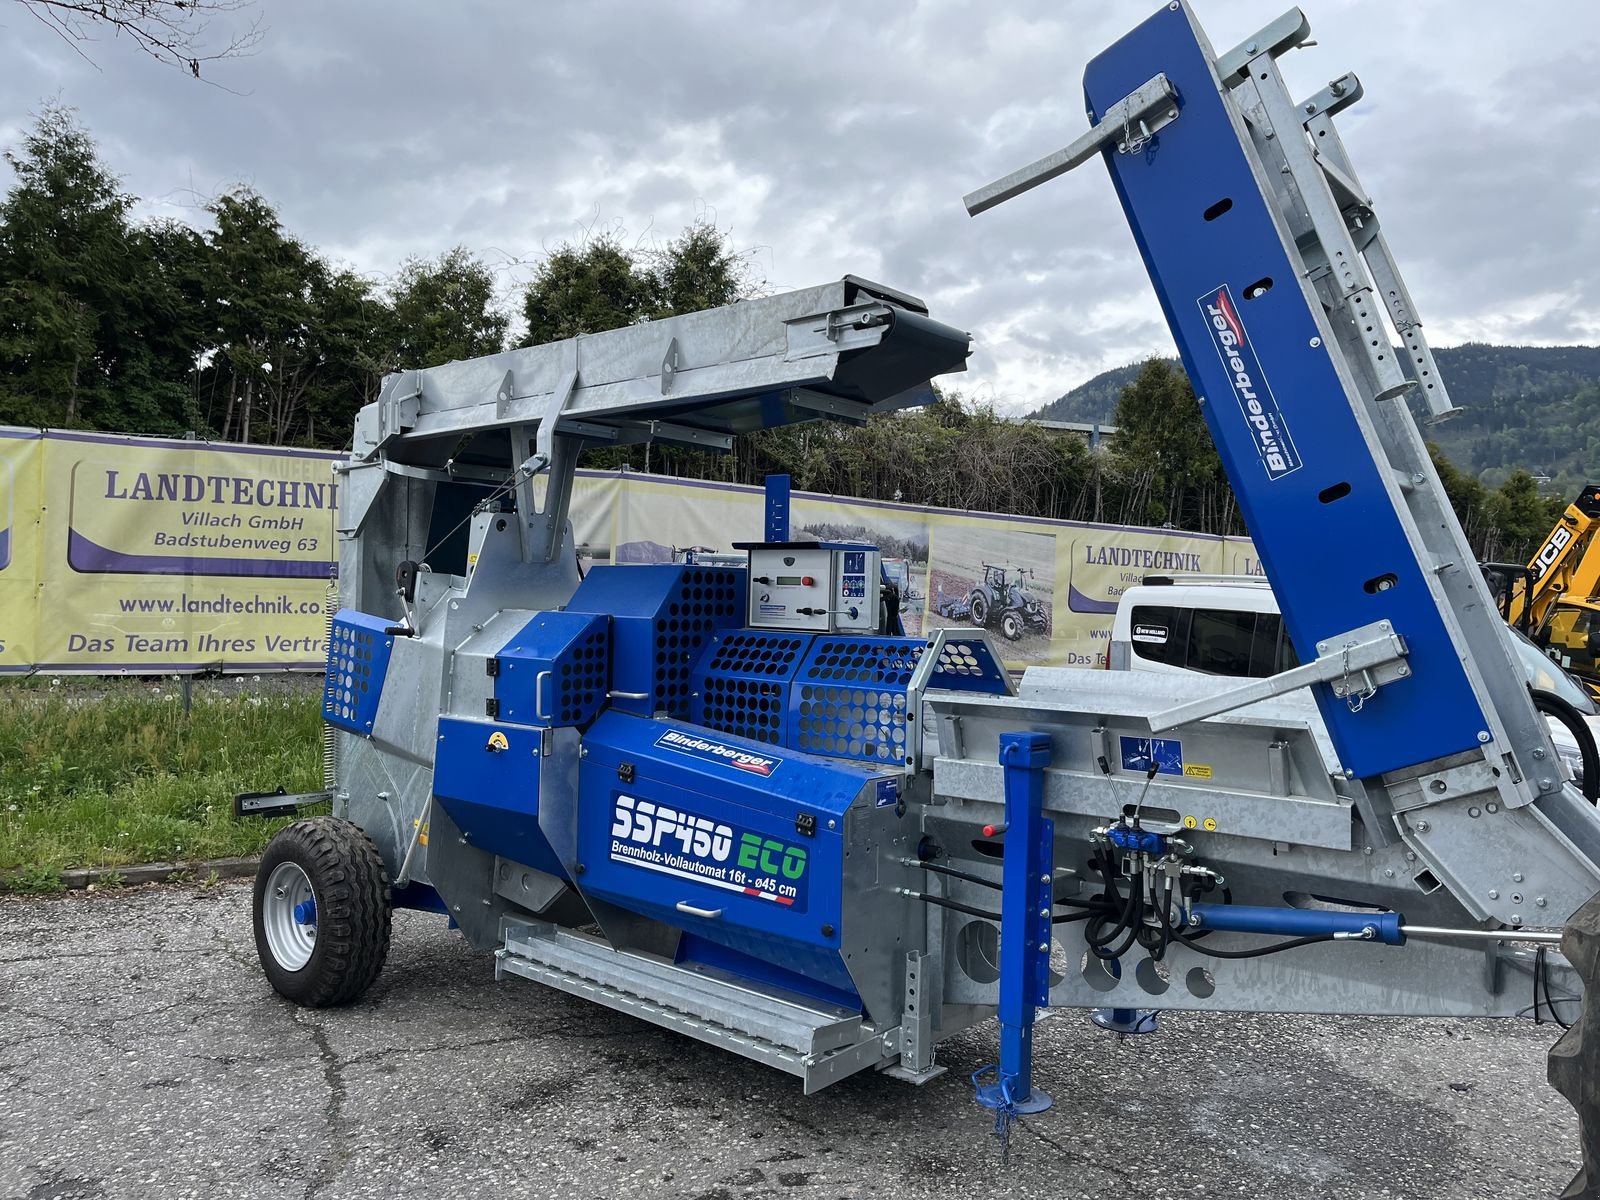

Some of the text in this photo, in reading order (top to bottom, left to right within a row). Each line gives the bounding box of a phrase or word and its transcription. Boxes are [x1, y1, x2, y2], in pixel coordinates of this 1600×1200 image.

[1207, 304, 1287, 471] Binderberger
[105, 470, 339, 510] LANDTECHNI
[181, 511, 304, 530] Villach GmbH
[154, 532, 318, 553] Badstubenweg 63
[1535, 527, 1571, 578] JCB
[1086, 545, 1200, 572] LANDTECHNIK
[120, 593, 325, 614] www.landtechnik.co.
[68, 634, 114, 652] Das
[125, 634, 188, 652] Team
[199, 634, 256, 652] Ihres
[1068, 653, 1091, 665] Das
[663, 732, 773, 767] Binderberger
[611, 795, 807, 880] SSP450 ECO
[611, 840, 726, 880] Brennholz-Vollautomat
[728, 868, 746, 884] 16t
[778, 880, 797, 897] cm
